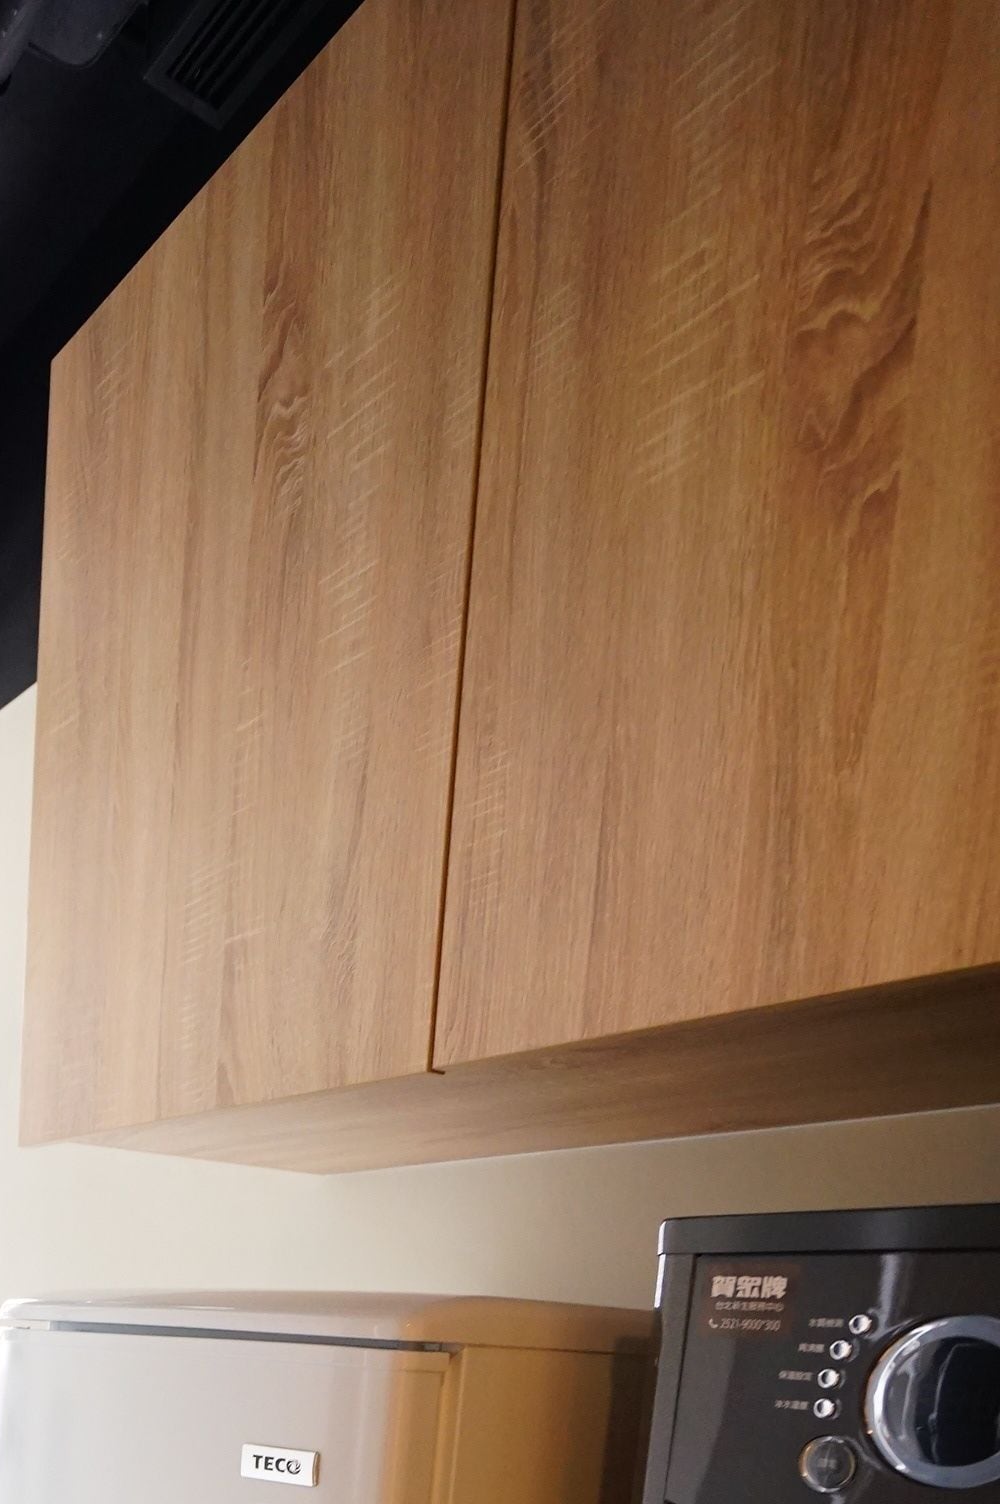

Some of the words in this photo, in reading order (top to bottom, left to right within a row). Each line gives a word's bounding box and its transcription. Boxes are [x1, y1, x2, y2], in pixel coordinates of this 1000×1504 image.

[711, 1275, 788, 1299] 賀眾牌
[252, 1454, 301, 1475] TECO
